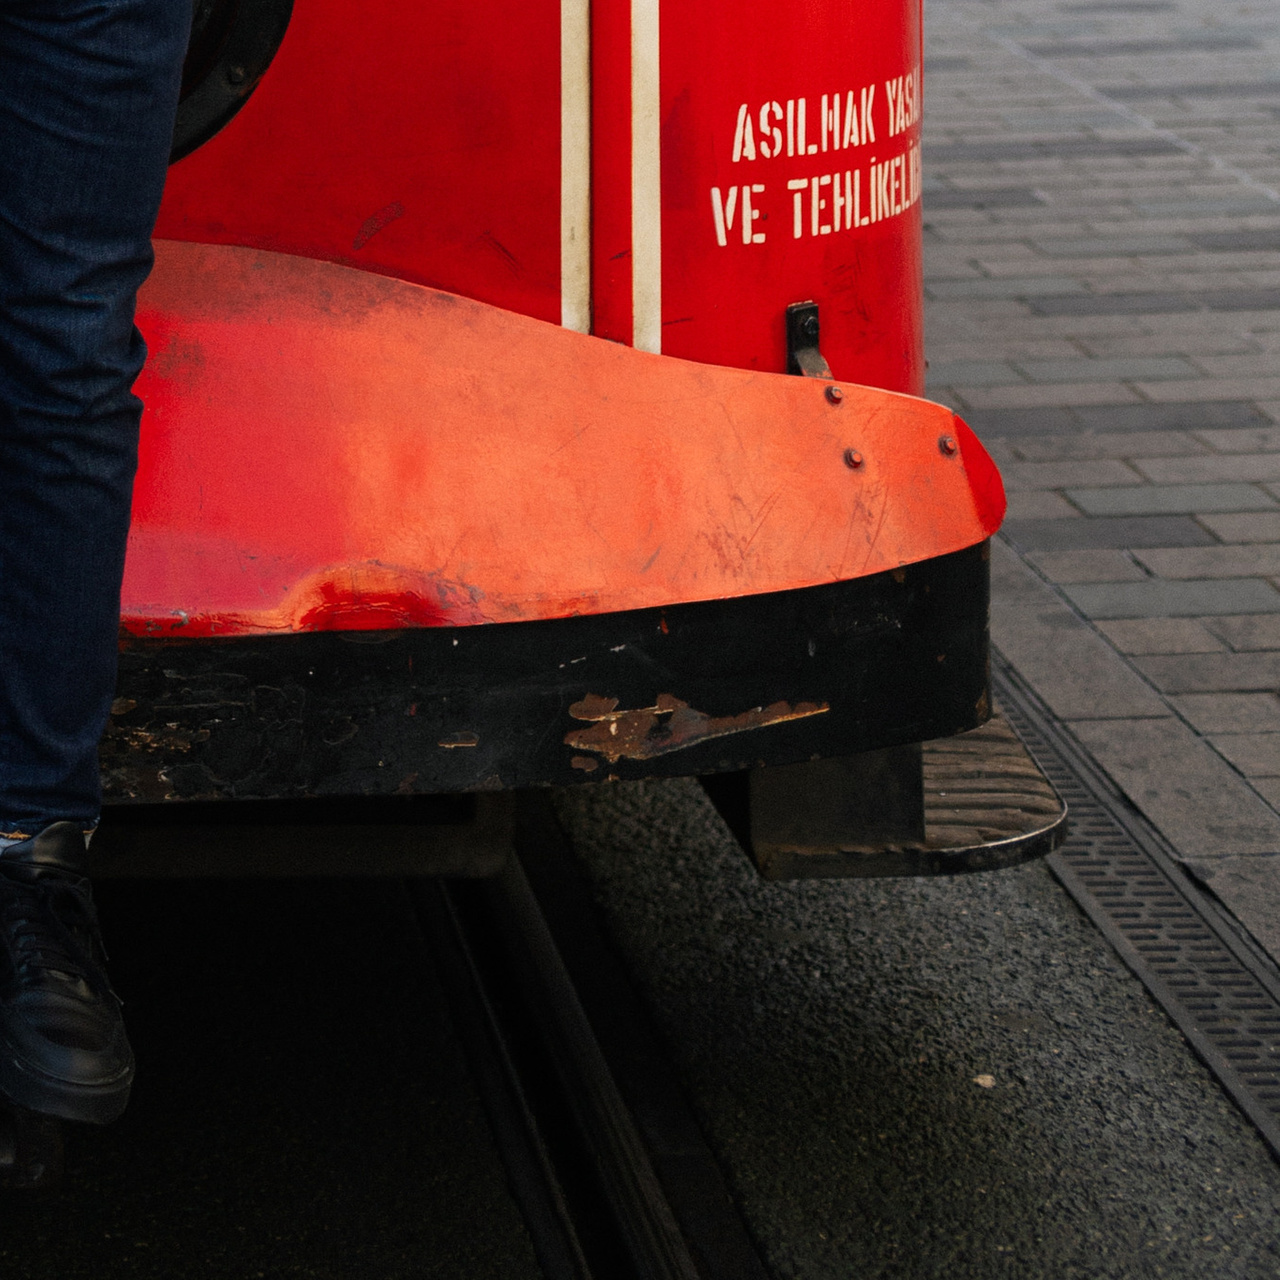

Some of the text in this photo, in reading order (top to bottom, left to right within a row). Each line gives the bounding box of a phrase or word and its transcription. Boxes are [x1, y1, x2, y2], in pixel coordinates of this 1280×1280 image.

[732, 62, 920, 162] ASILMAK YASA
[710, 183, 766, 247] VE
